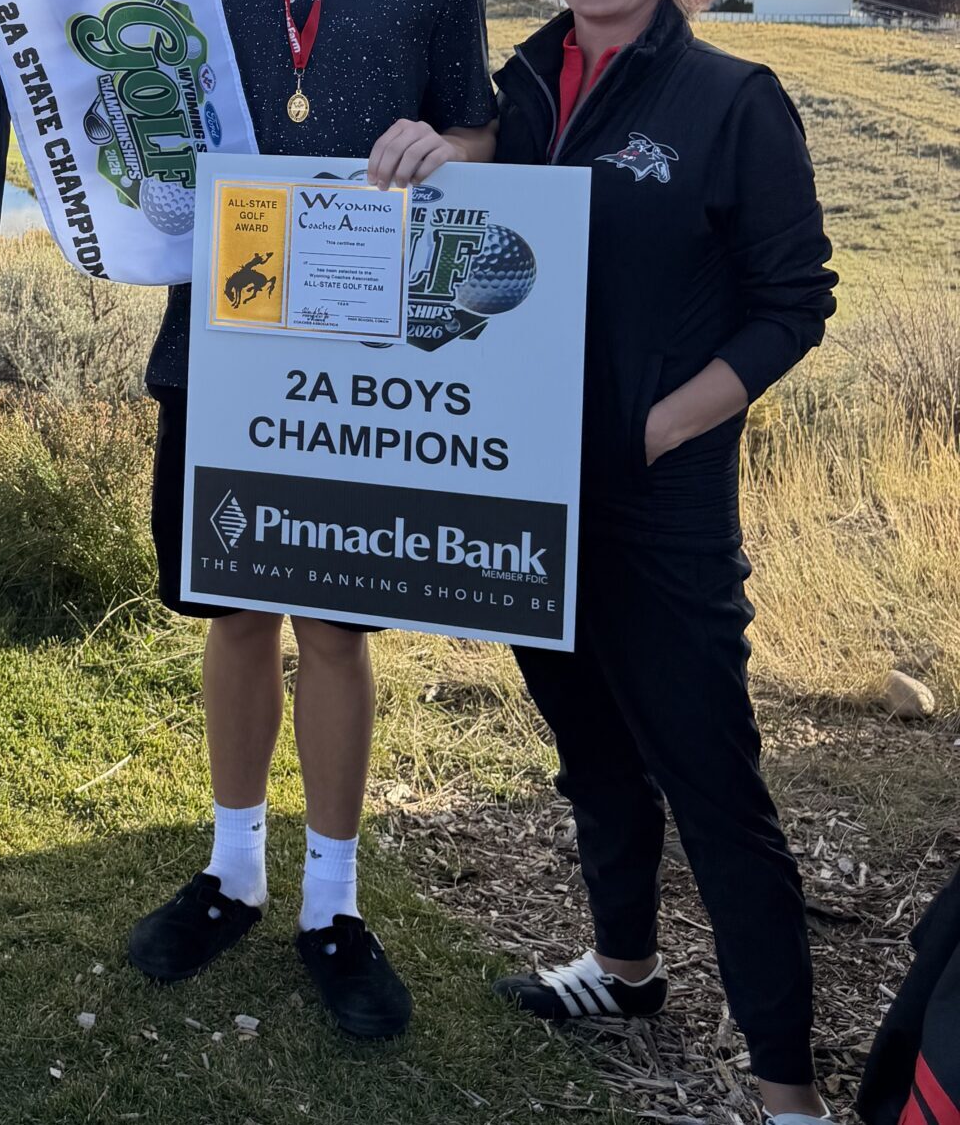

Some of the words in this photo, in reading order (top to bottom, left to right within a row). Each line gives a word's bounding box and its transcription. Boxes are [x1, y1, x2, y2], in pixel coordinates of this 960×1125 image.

[70, 1, 196, 189] GOLF
[178, 67, 205, 139] WYOMING
[99, 75, 142, 180] CHAMPIONSHIPS
[12, 47, 64, 136] STATE
[44, 137, 111, 279] CHAMPION
[104, 149, 122, 175] 2026
[228, 199, 277, 209] ALL-STATE
[300, 191, 392, 213] WYOMING
[235, 223, 268, 233] AWARD
[240, 211, 265, 221] GOLF
[298, 212, 336, 231] Coaches
[338, 214, 396, 234] Association
[432, 208, 490, 225] STATE
[304, 280, 341, 289] ALL-STATE
[342, 283, 362, 291] GOLF
[407, 325, 443, 339] 2026
[285, 369, 338, 404] 2A
[351, 375, 472, 415] BOYS
[248, 416, 510, 471] CHAMPIONS
[255, 505, 430, 563] Pinnacle
[437, 525, 546, 575] Bank
[201, 557, 238, 572] THE
[252, 563, 294, 578] WAY
[309, 571, 408, 593] BANKING
[424, 585, 514, 606] SHOULD
[531, 597, 556, 612] BE
[482, 569, 523, 582] MEMBER
[526, 574, 548, 585] FDIC
